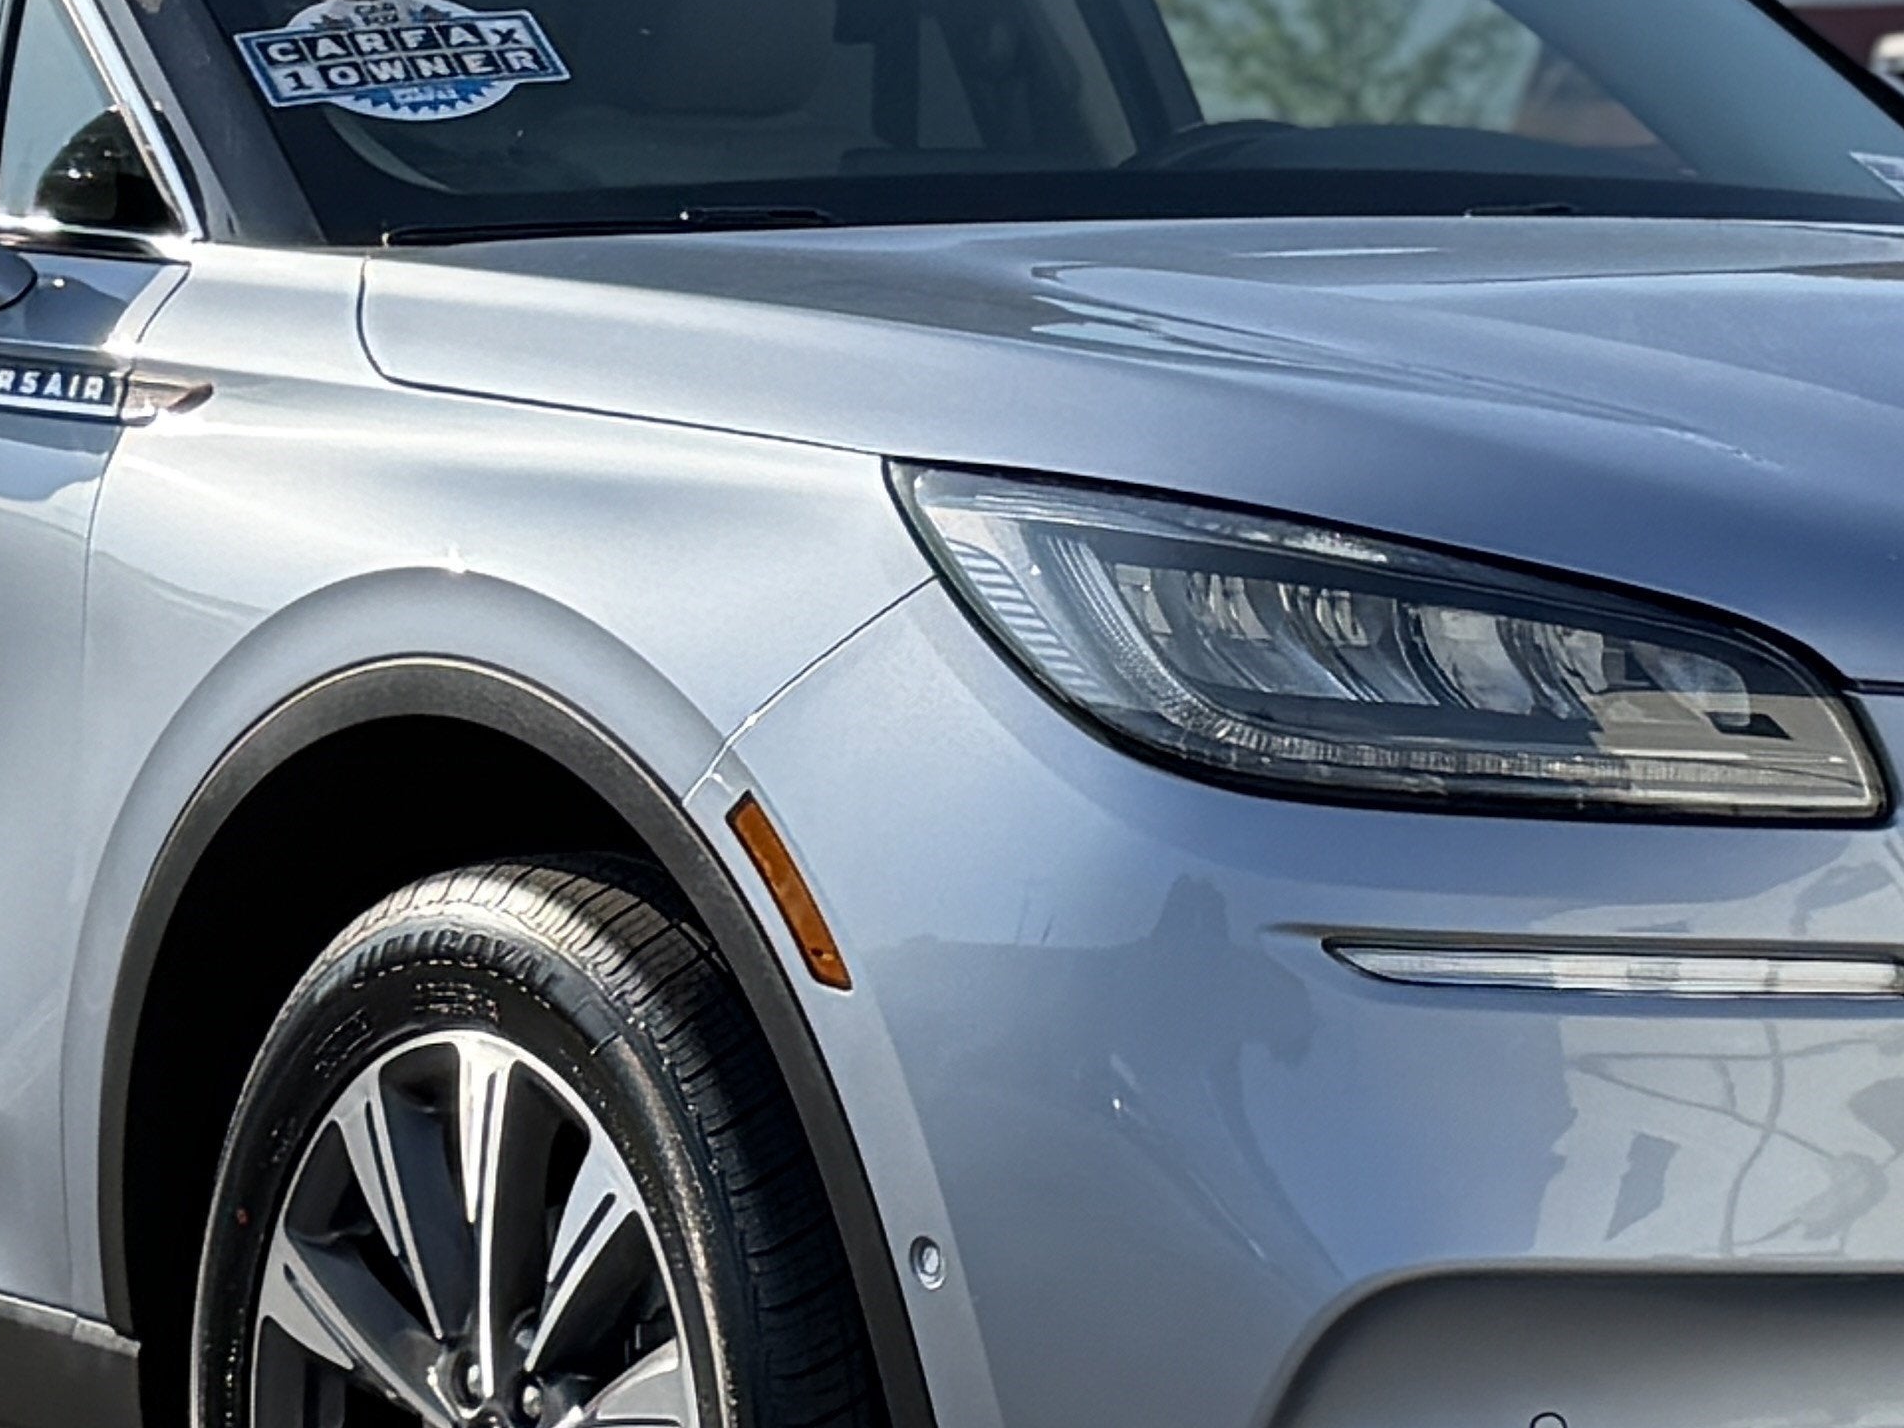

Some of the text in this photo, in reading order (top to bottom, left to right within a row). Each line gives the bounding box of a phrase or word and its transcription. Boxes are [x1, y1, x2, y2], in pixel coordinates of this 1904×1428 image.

[266, 25, 524, 65] CARFAX
[283, 49, 542, 92] 1 OWNER
